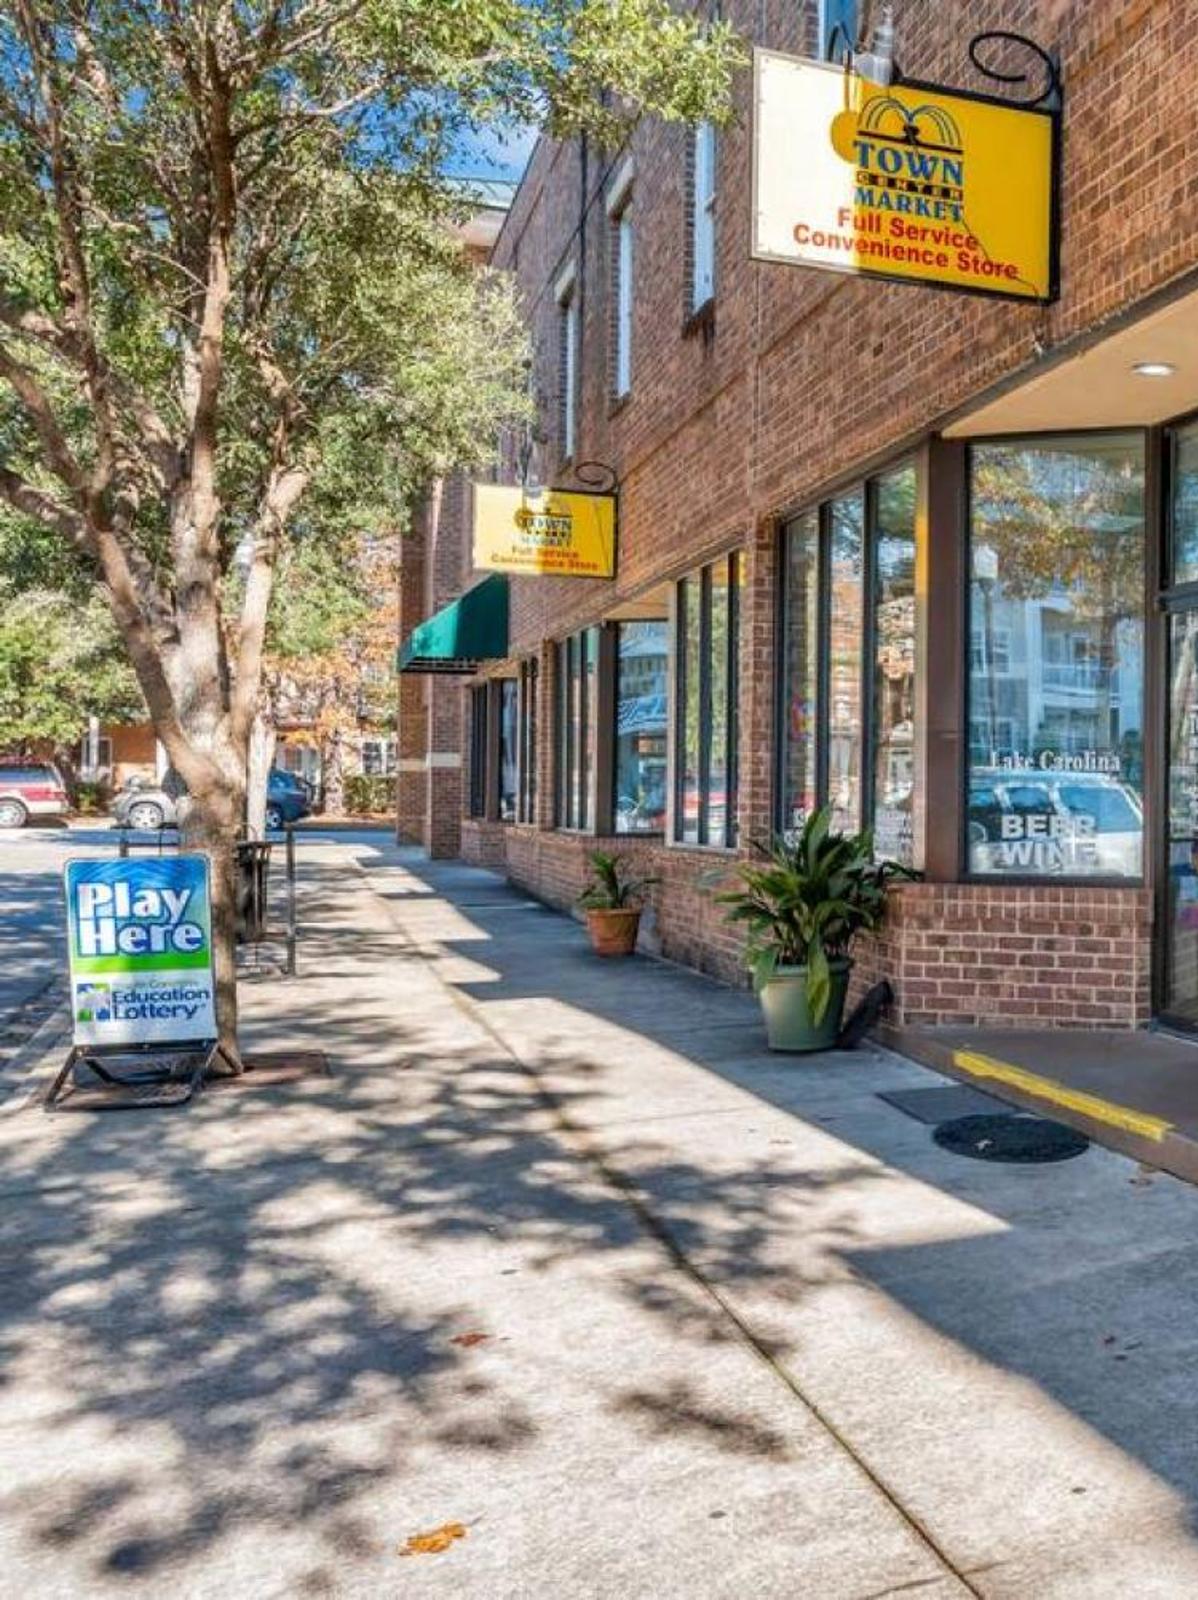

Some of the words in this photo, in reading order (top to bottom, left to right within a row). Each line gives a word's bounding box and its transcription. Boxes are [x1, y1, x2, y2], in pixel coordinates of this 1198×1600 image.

[853, 141, 963, 186] TOWN
[854, 186, 964, 222] MARKET
[837, 206, 880, 233] Full
[889, 216, 980, 251] Service
[793, 223, 949, 268] Convenience
[957, 257, 1020, 280] Store
[991, 751, 1034, 771] Lake
[1040, 750, 1121, 771] Carolina
[1001, 814, 1097, 840] BEER
[76, 881, 192, 925] Play
[80, 918, 204, 956] Here
[112, 986, 210, 1004] Education
[113, 1003, 199, 1020] Lottery
